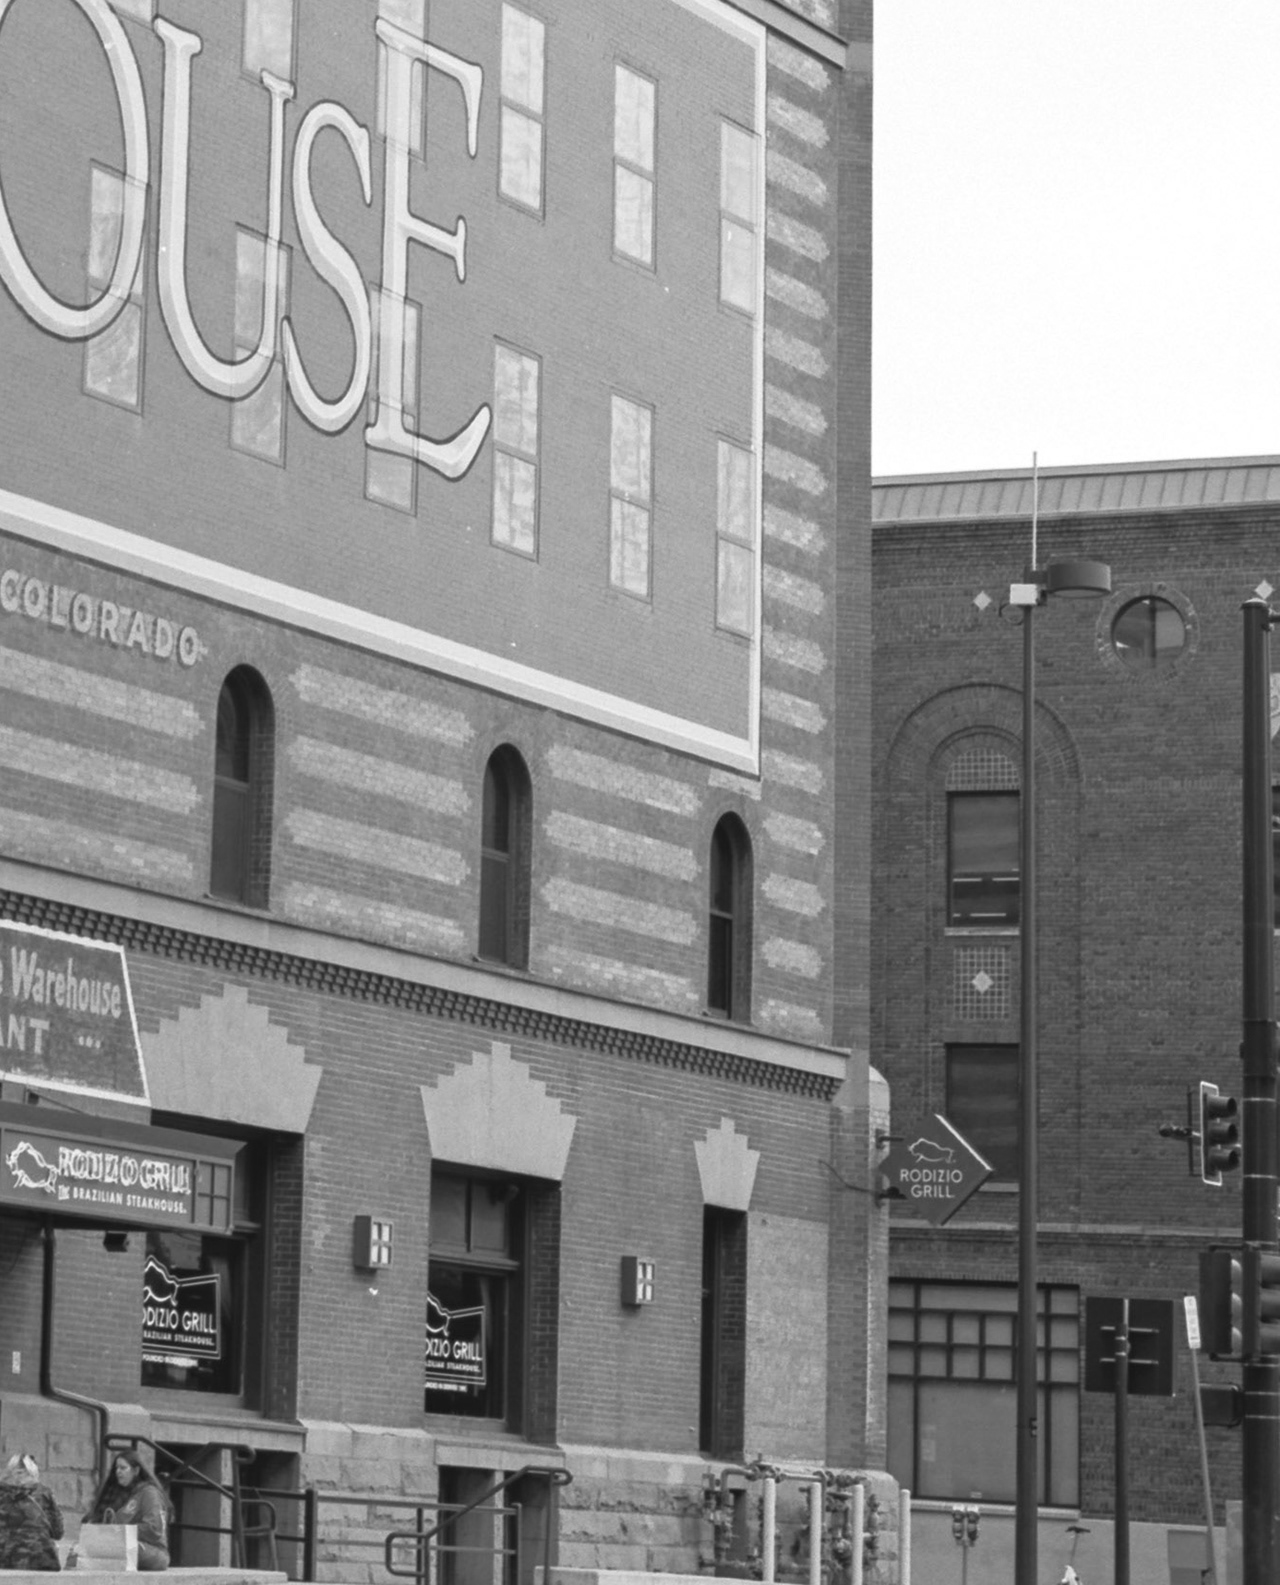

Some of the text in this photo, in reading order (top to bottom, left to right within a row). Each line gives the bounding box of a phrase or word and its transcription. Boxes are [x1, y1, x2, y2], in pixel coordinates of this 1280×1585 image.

[10, 946, 122, 1018] Warehouse
[58, 1146, 192, 1194] RODIZIO GRILL
[900, 1168, 963, 1183] RODIZIO
[73, 1187, 123, 1206] BRAZILIAN
[910, 1184, 955, 1198] GRILL
[142, 1306, 218, 1334] DIZIO GRILL
[453, 1341, 483, 1361] GRILL
